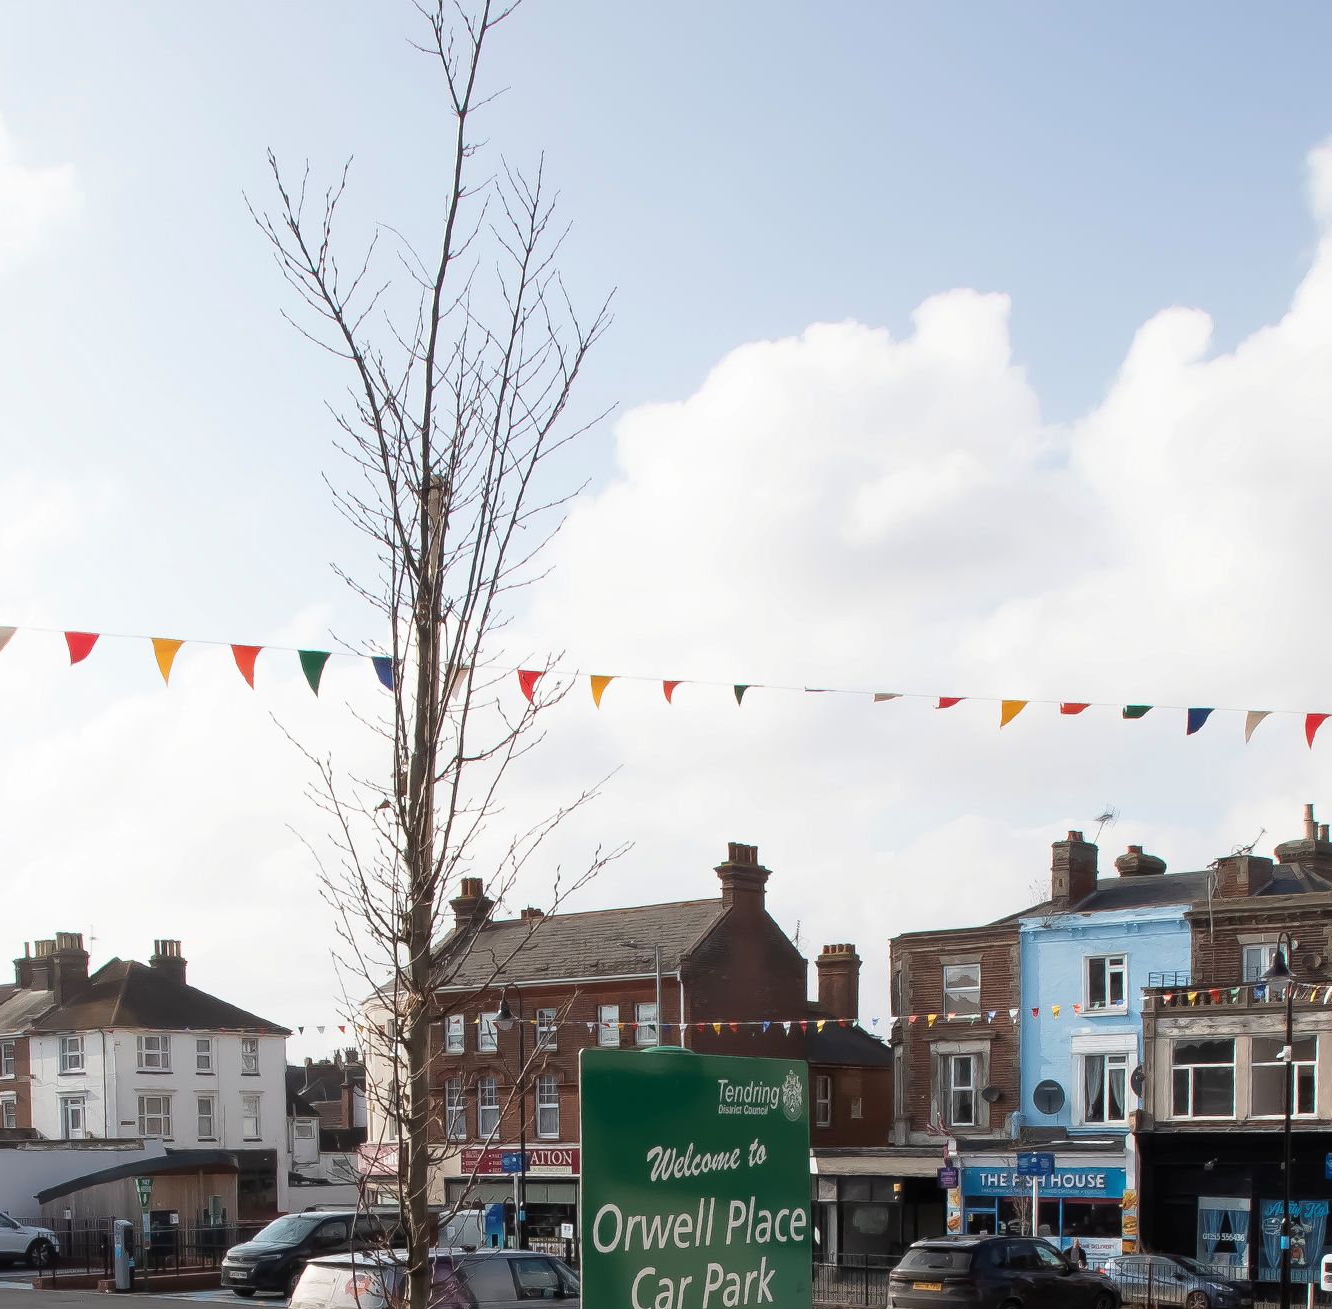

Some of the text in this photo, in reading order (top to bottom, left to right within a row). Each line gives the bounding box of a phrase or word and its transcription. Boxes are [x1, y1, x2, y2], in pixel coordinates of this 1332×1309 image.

[718, 1080, 780, 1109] Tendring
[718, 1105, 768, 1114] District Council
[646, 1138, 767, 1181] Welcome to
[980, 1173, 1106, 1188] THE FSH HOUSE
[592, 1196, 808, 1254] Orwell Place
[701, 1256, 776, 1309] Park
